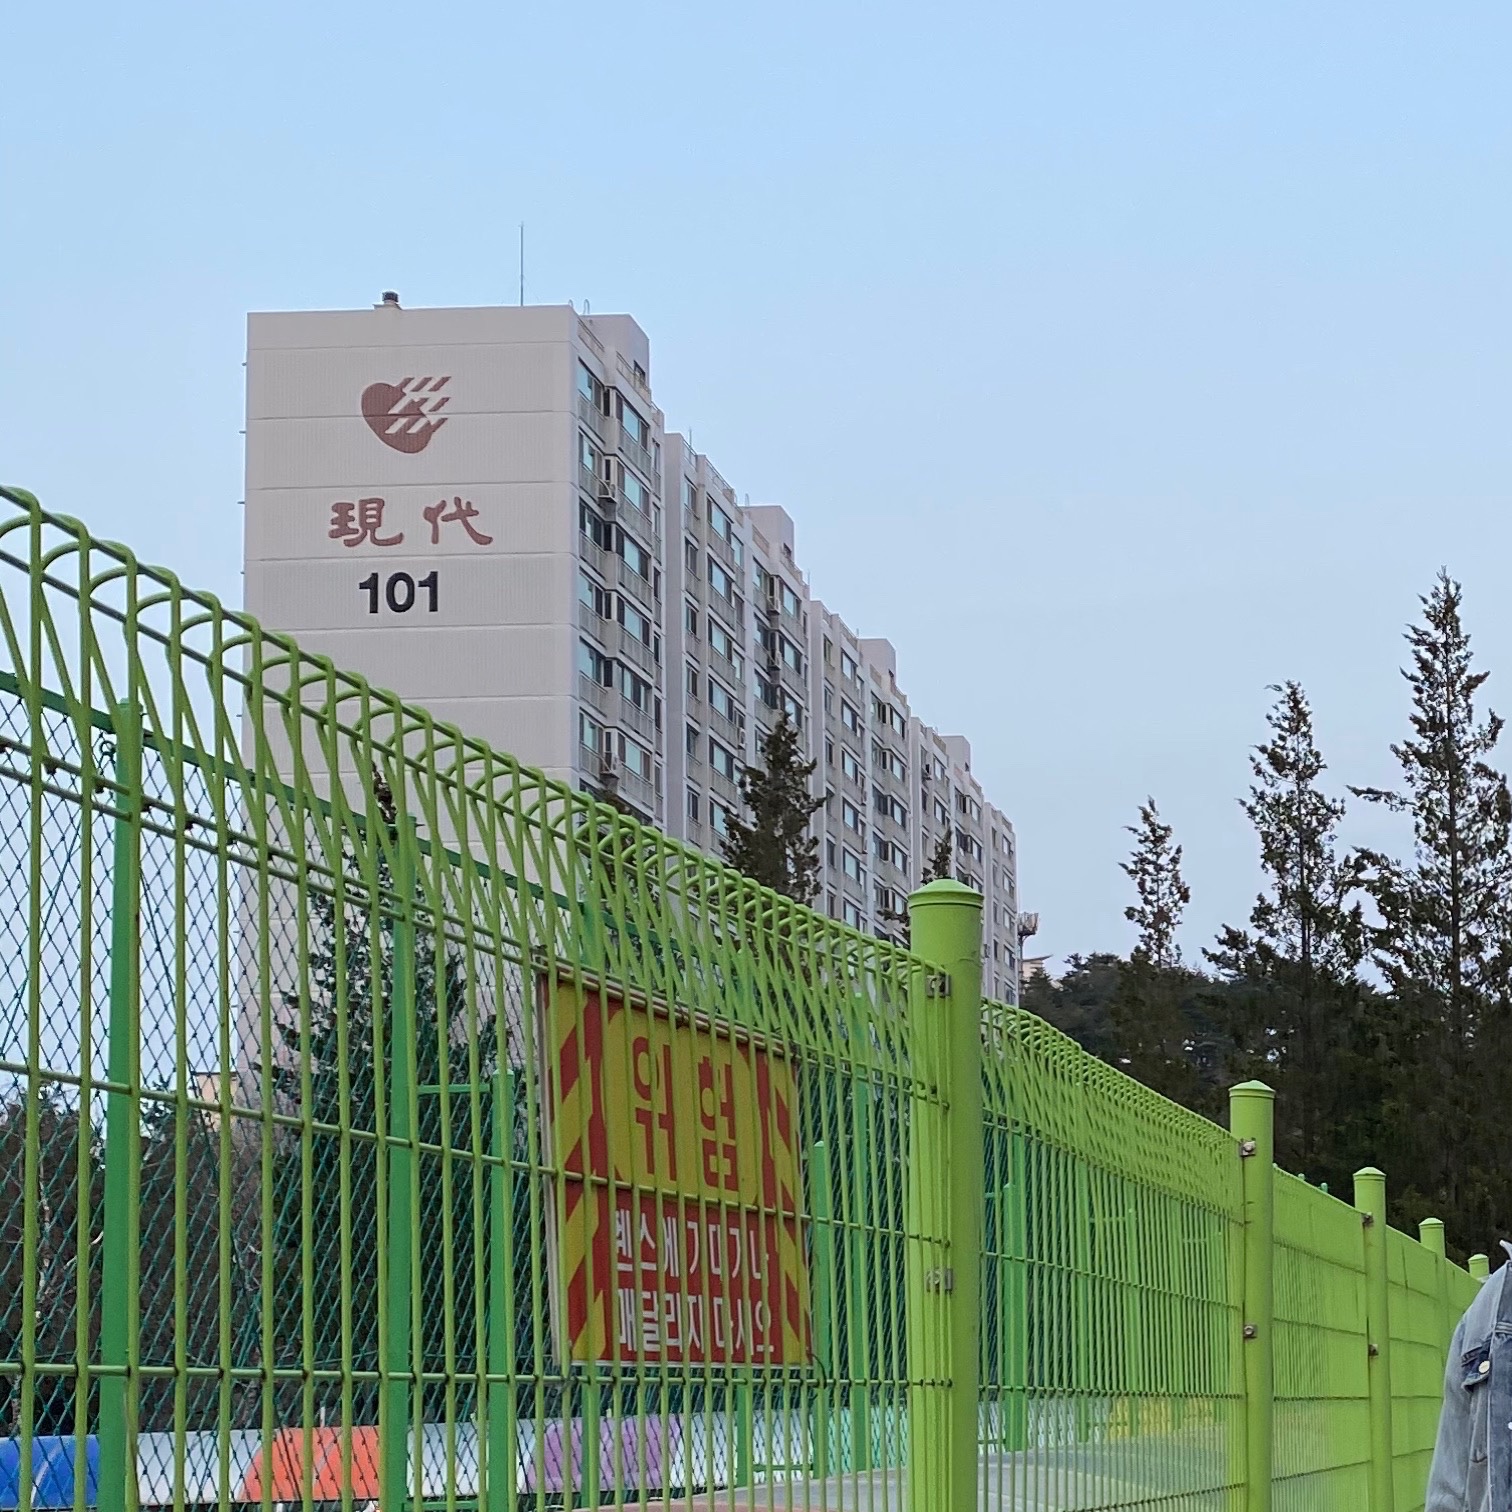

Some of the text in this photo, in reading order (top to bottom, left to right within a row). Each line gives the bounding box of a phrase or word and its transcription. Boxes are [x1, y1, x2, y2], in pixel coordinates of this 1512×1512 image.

[328, 497, 493, 548] 現代
[358, 571, 439, 613] 101
[632, 1036, 739, 1192] 위험
